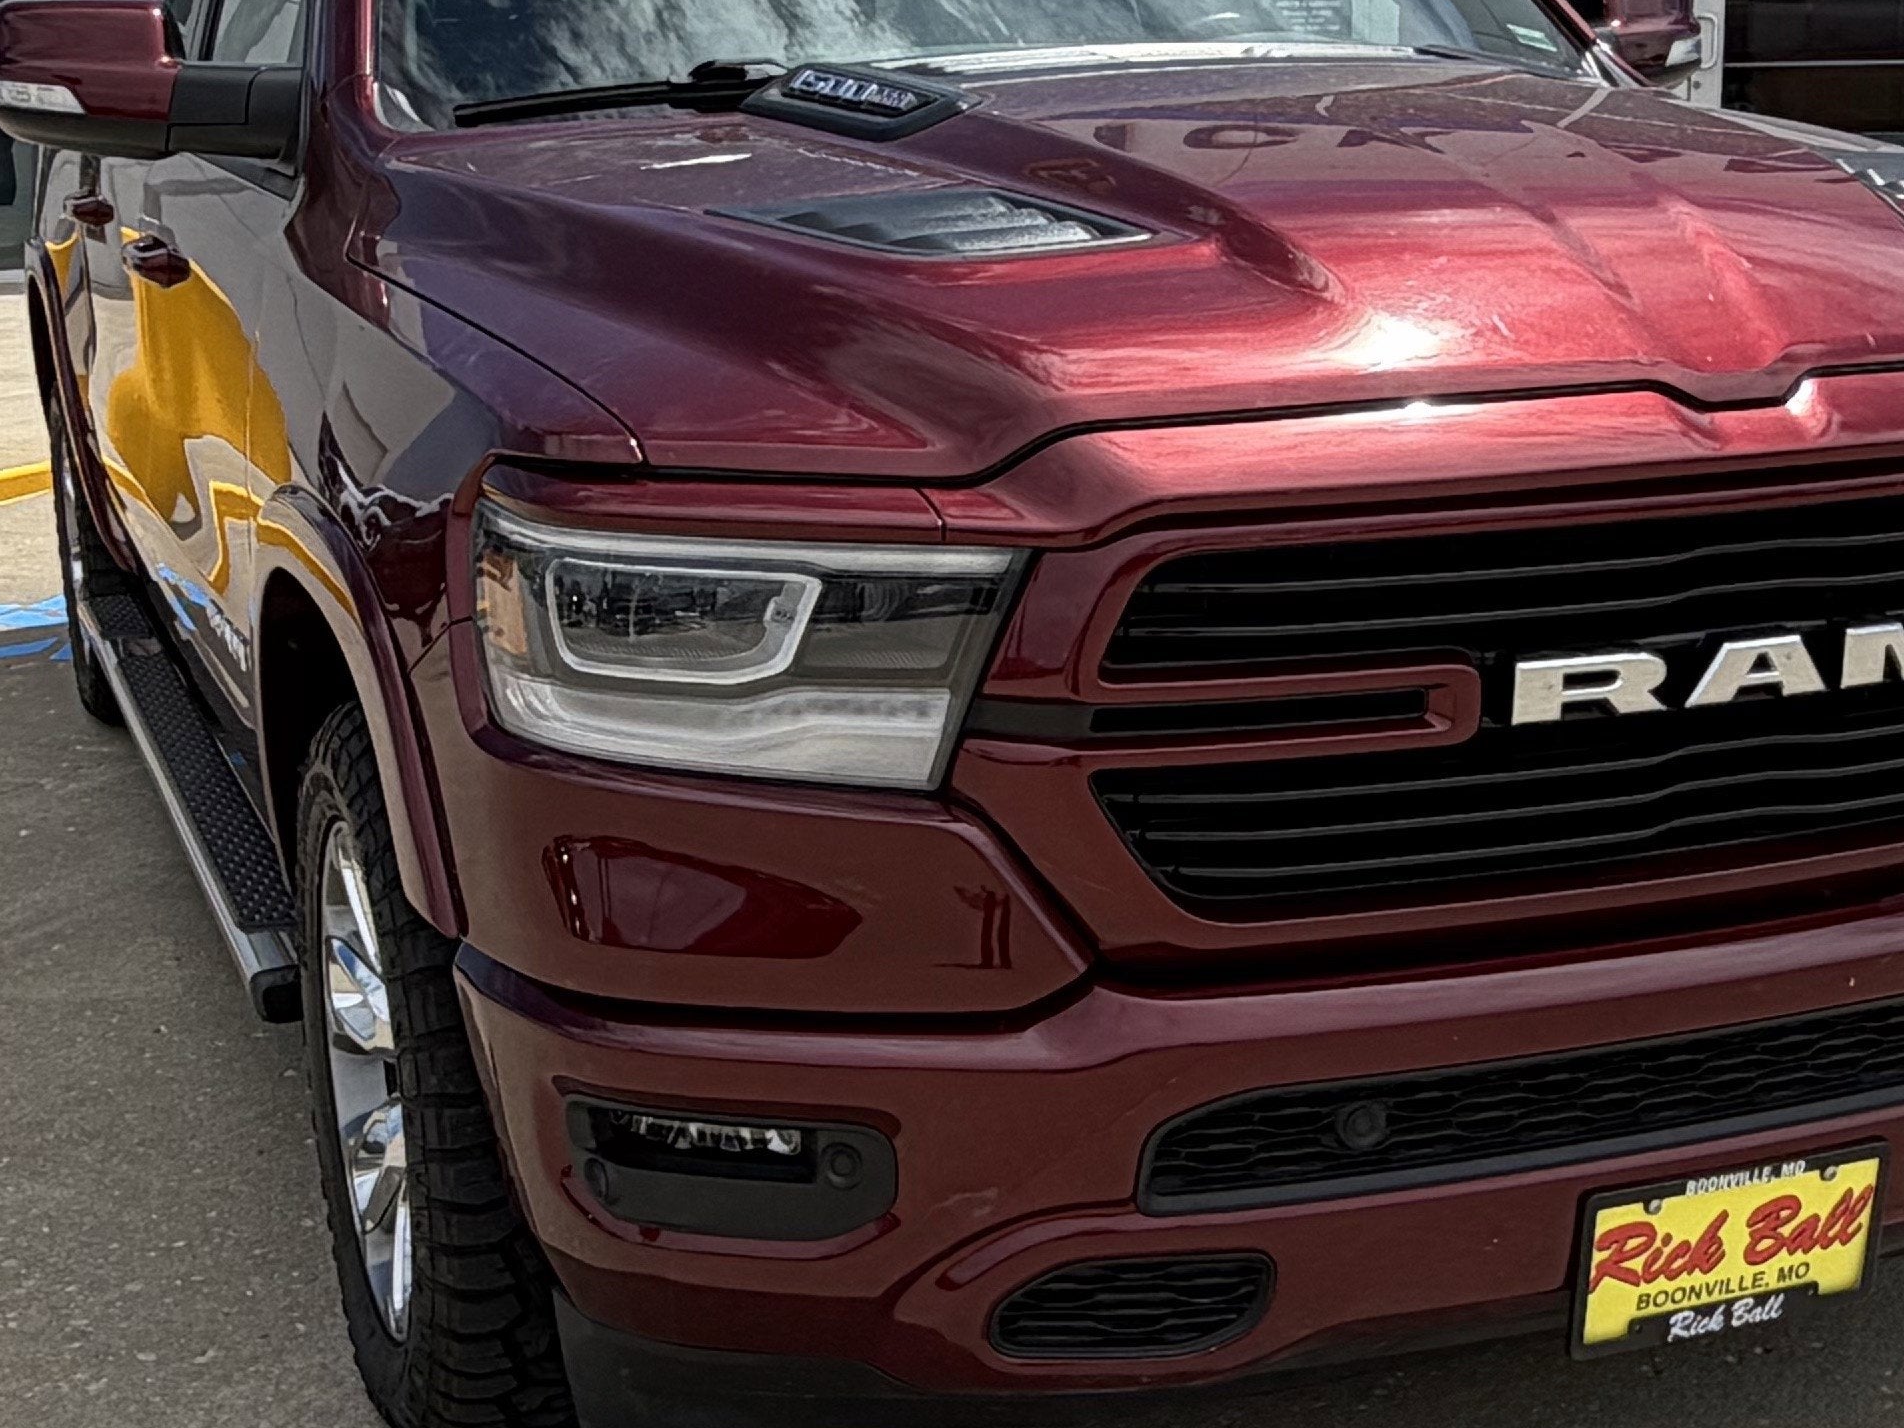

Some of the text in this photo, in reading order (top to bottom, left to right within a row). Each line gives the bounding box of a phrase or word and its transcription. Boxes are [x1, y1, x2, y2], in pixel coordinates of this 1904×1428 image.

[1685, 1160, 1806, 1196] BOONVILLE, MO
[1589, 1183, 1874, 1293] Rick Ball
[1636, 1262, 1811, 1311] BOONVILLE, MO
[1667, 1293, 1784, 1343] Rick Ball
